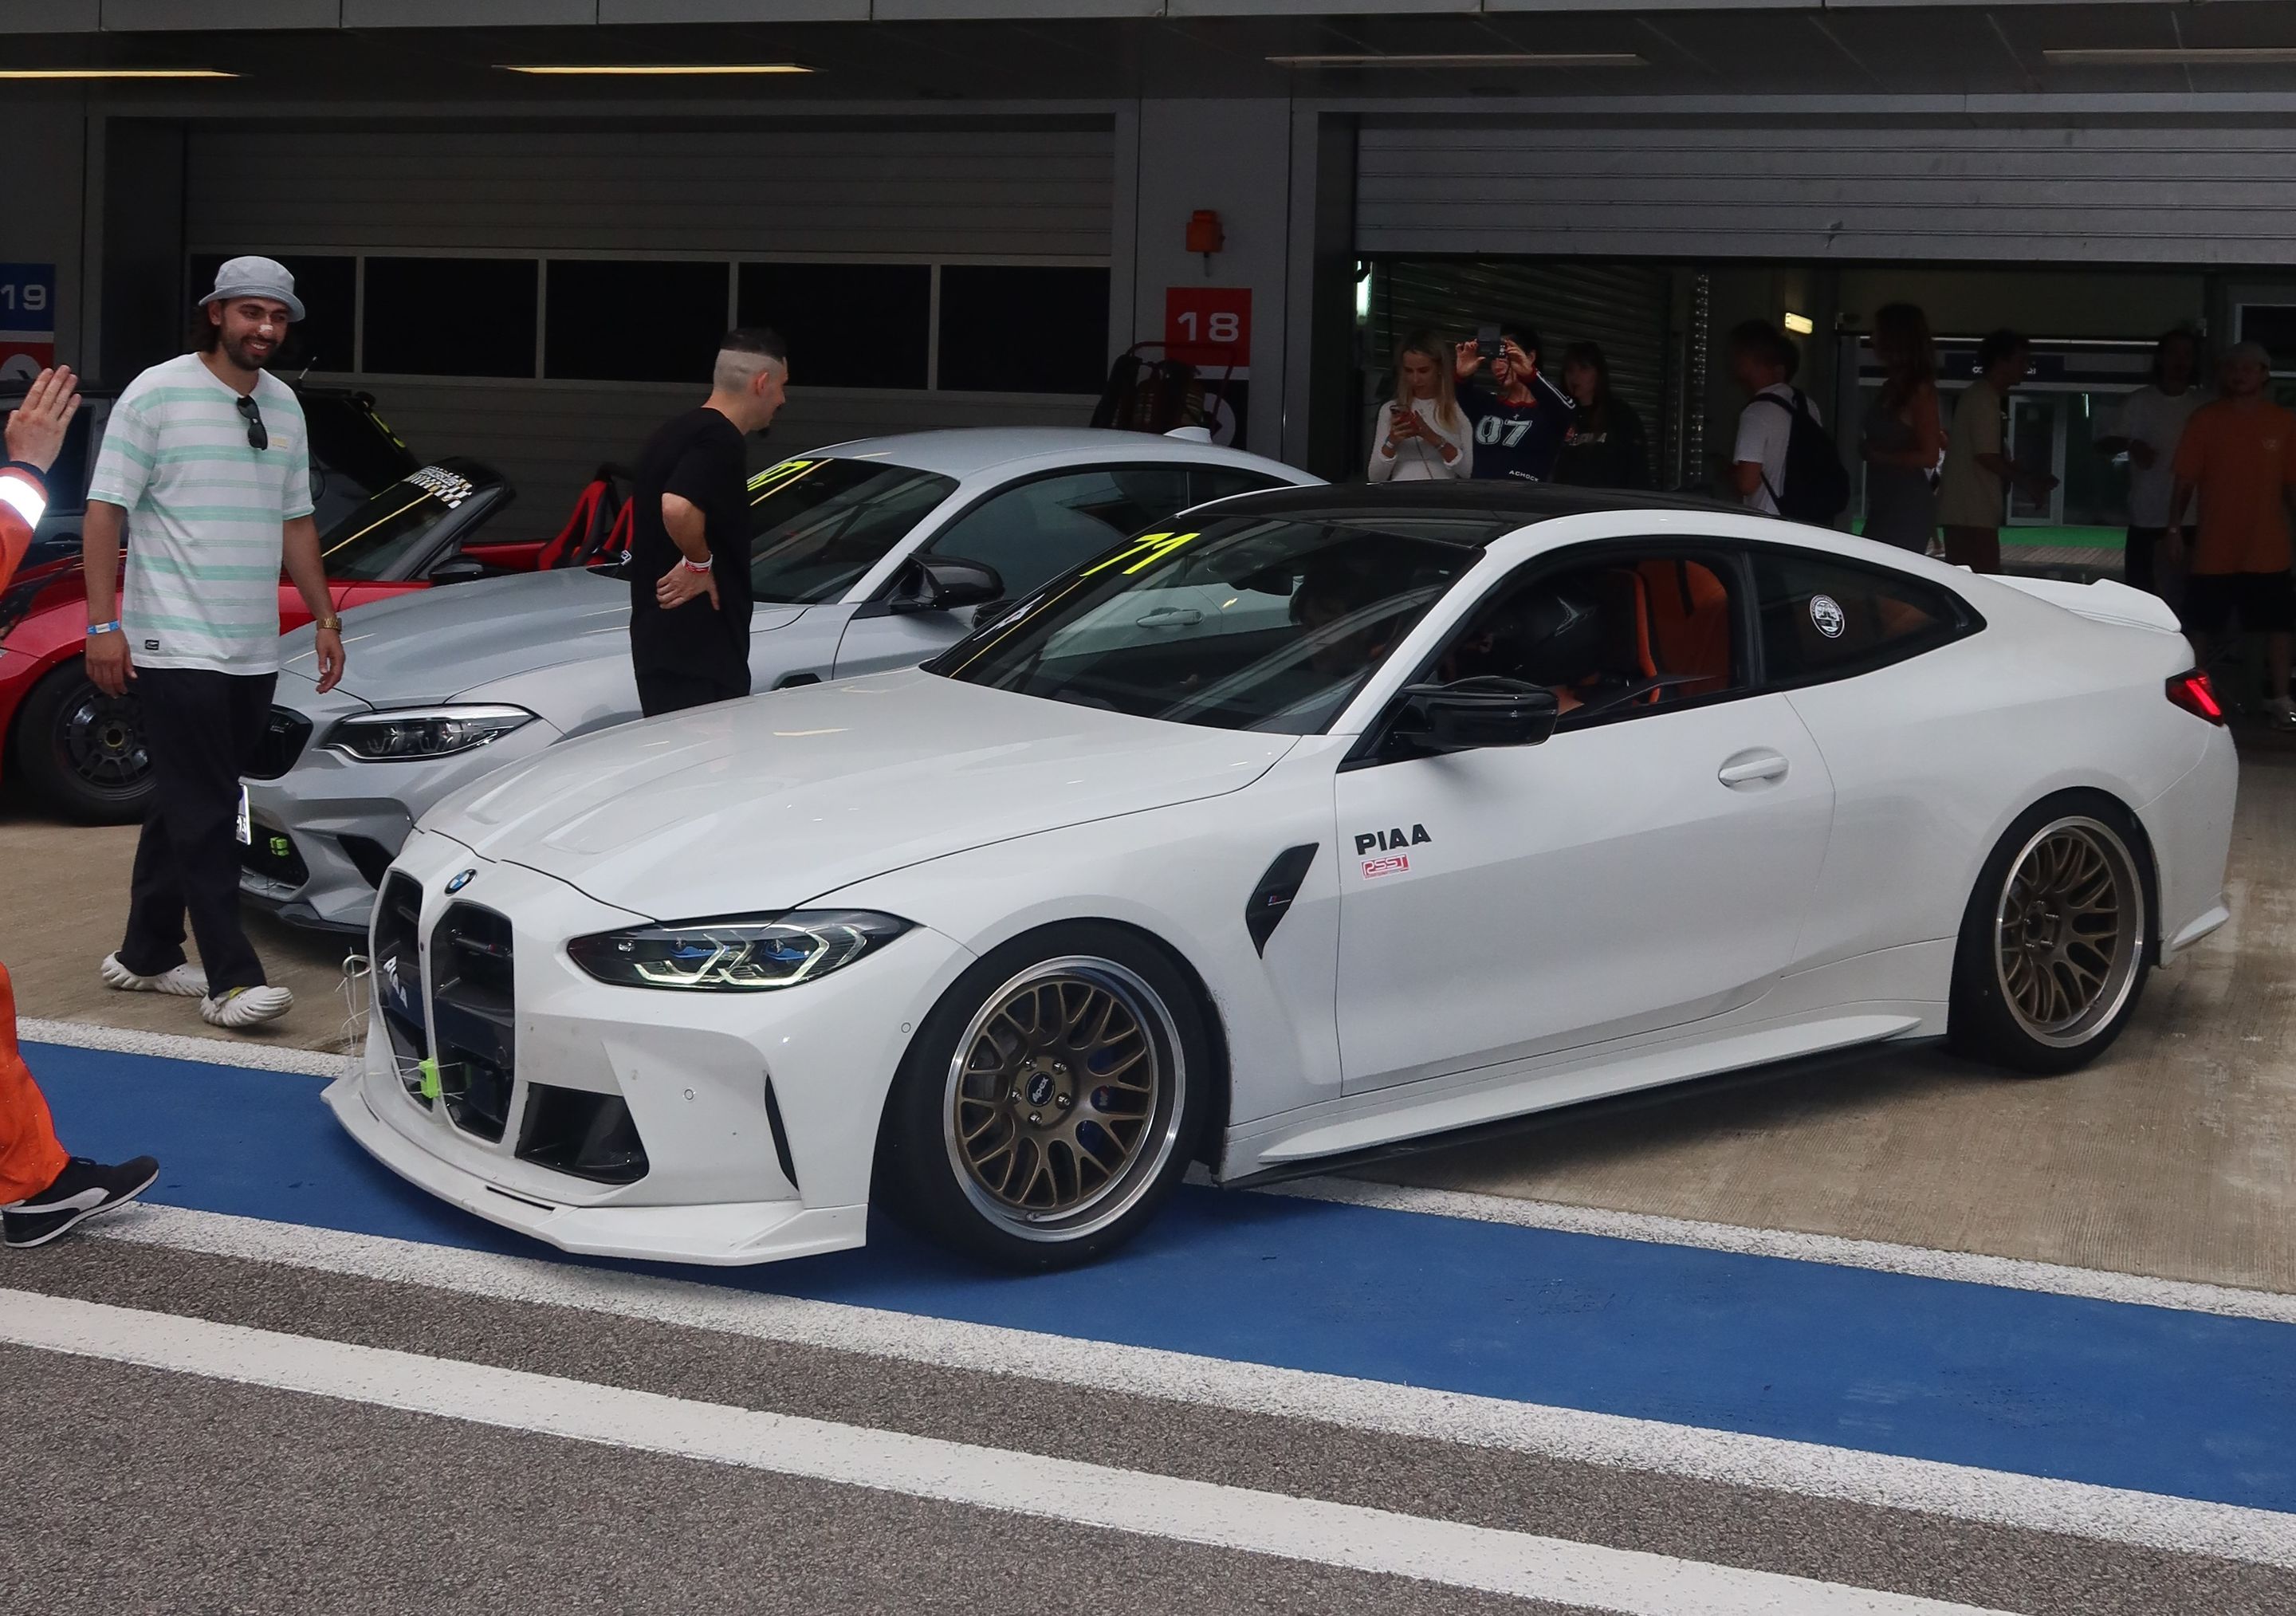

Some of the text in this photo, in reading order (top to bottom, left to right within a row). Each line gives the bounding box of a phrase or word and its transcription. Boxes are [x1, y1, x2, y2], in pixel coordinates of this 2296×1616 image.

[1, 284, 46, 310] 19
[1177, 312, 1239, 342] 18
[1476, 415, 1533, 447] 07
[1354, 824, 1432, 855] PIAA
